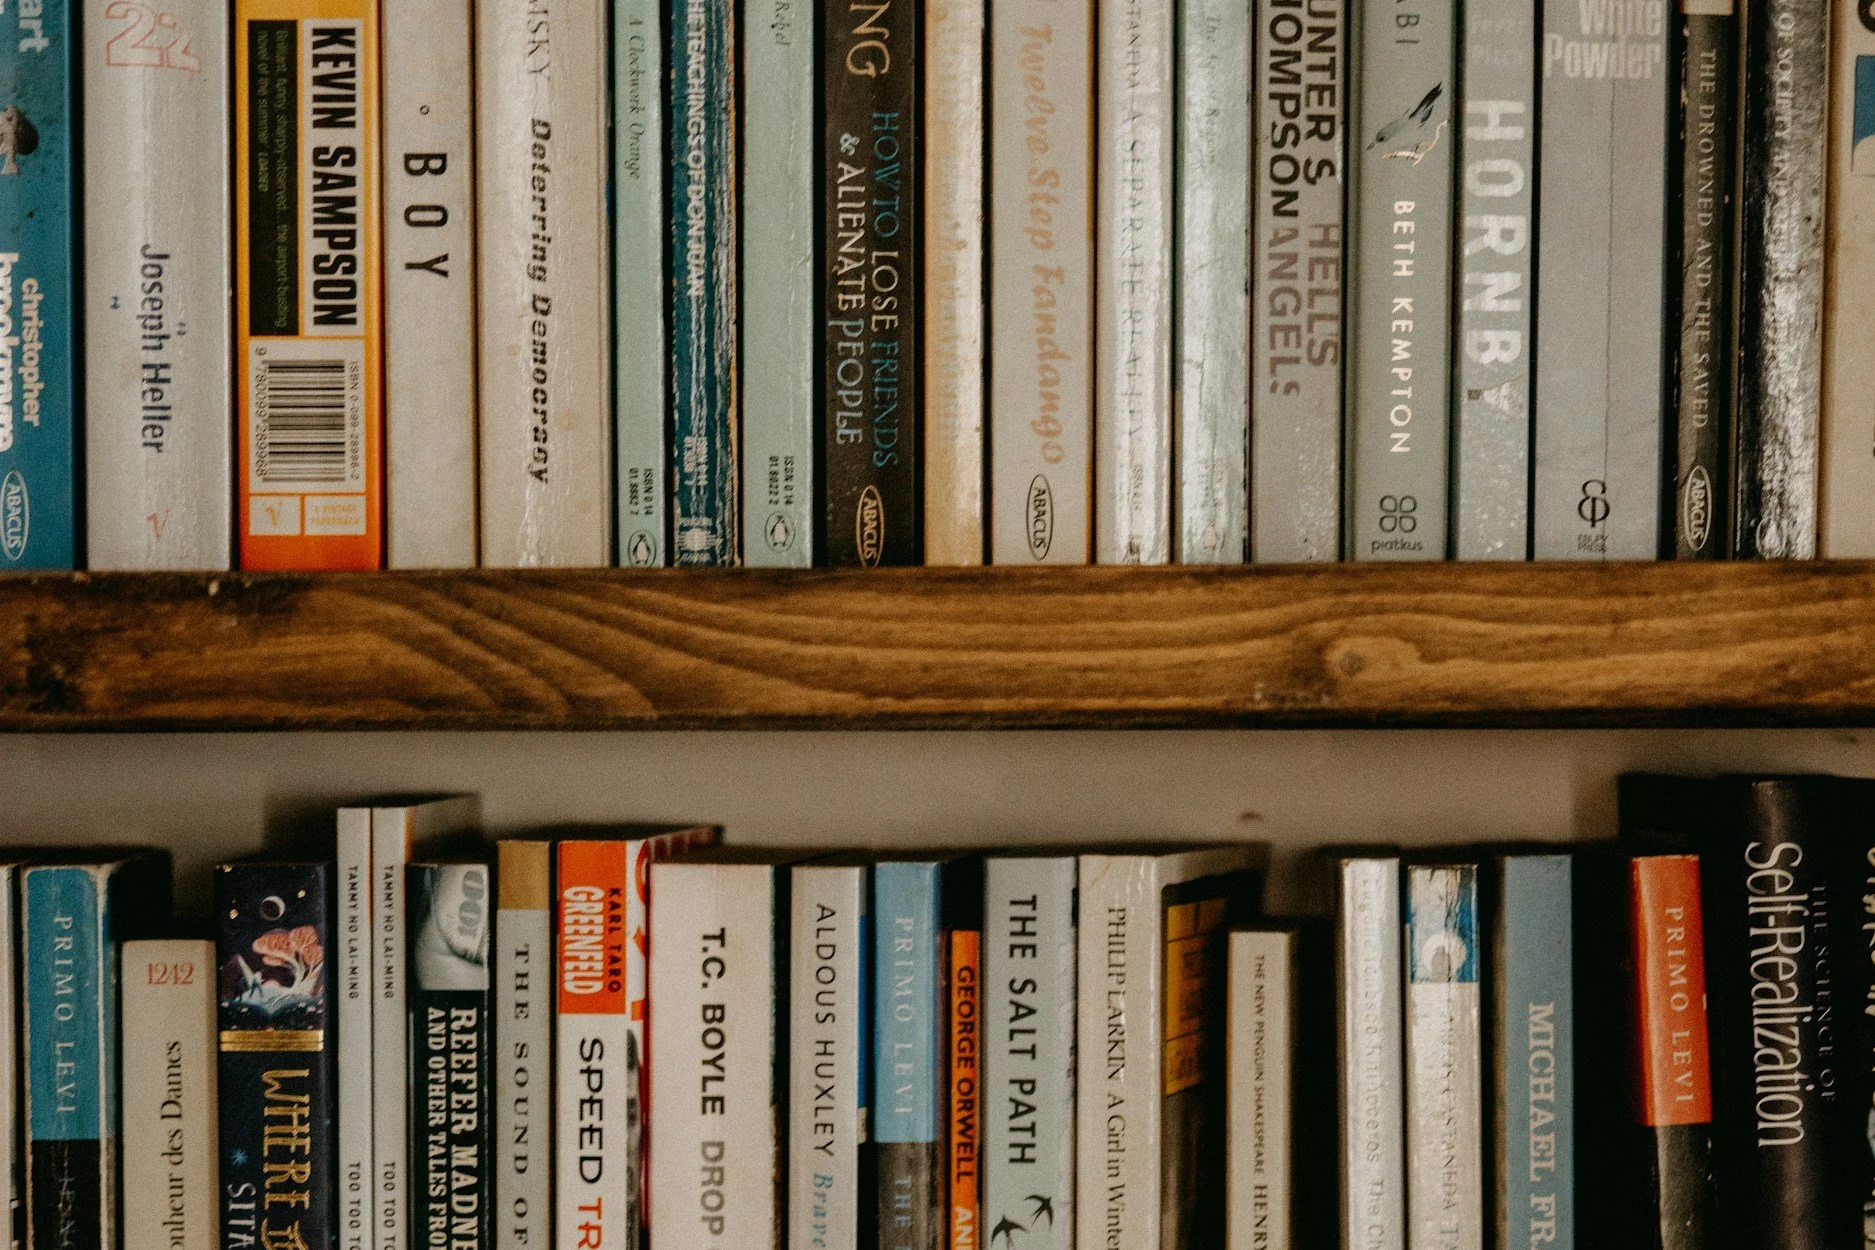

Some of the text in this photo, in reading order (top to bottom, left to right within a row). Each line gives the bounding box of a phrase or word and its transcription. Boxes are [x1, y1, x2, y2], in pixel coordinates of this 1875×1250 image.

[625, 14, 646, 179] A Clockwork Orange
[1544, 33, 1662, 79] Powder
[312, 28, 358, 326] KEVIN SAMPSON
[870, 111, 900, 468] HOW TO LOSE FRIENDS
[1019, 24, 1071, 465] Twelve Step Fandango
[1691, 49, 1716, 428] THE DROWNED AND THE SAVED
[21, 278, 44, 427] christopher
[137, 244, 172, 454] Joseph Heller
[350, 362, 360, 390] ISBN
[1390, 200, 1415, 454] BETH KEMPTON
[6, 483, 22, 548] ABACUS
[863, 495, 877, 559] ABACUS
[1033, 487, 1047, 549] ABACUS
[1372, 538, 1424, 553] piatkus
[1690, 478, 1707, 541] ABACUS
[514, 943, 530, 1019] THE
[563, 885, 604, 994] GREENFELD
[607, 886, 622, 993] KARL TARO
[701, 928, 726, 988] T.C.
[814, 904, 837, 1024] ALDOUS
[894, 917, 913, 1023] PRIMO
[1254, 955, 1265, 981] THE
[1664, 907, 1690, 1012] PRIMO
[53, 916, 76, 1113] PRIMO LEVI
[428, 1008, 446, 1051] AND
[957, 966, 974, 1069] GEORGE
[1008, 895, 1038, 1165] THE SALT PATH
[1254, 984, 1265, 1017] NEW
[1744, 840, 1815, 1148] Self-Realization
[428, 1055, 446, 1127] OTHER
[450, 1008, 478, 1135] REEFER
[701, 1003, 726, 1115] BOYLE
[813, 1040, 836, 1158] HUXLEY
[895, 1042, 913, 1114] LEVI
[1254, 1020, 1266, 1082] PENGUIN
[1528, 1002, 1555, 1181] MICHAEL
[1671, 1031, 1693, 1103] LEVI
[513, 1041, 530, 1176] SOUND
[580, 1037, 603, 1184] SPEED
[956, 1077, 974, 1183] ORWELL
[1254, 1085, 1266, 1175] SHAKESPEARE
[228, 1182, 257, 1248] SITA
[428, 1131, 447, 1197] TALES
[700, 1140, 726, 1236] DROP
[812, 1172, 834, 1249] Brave
[896, 1178, 912, 1226] THE
[513, 1197, 530, 1244] OF
